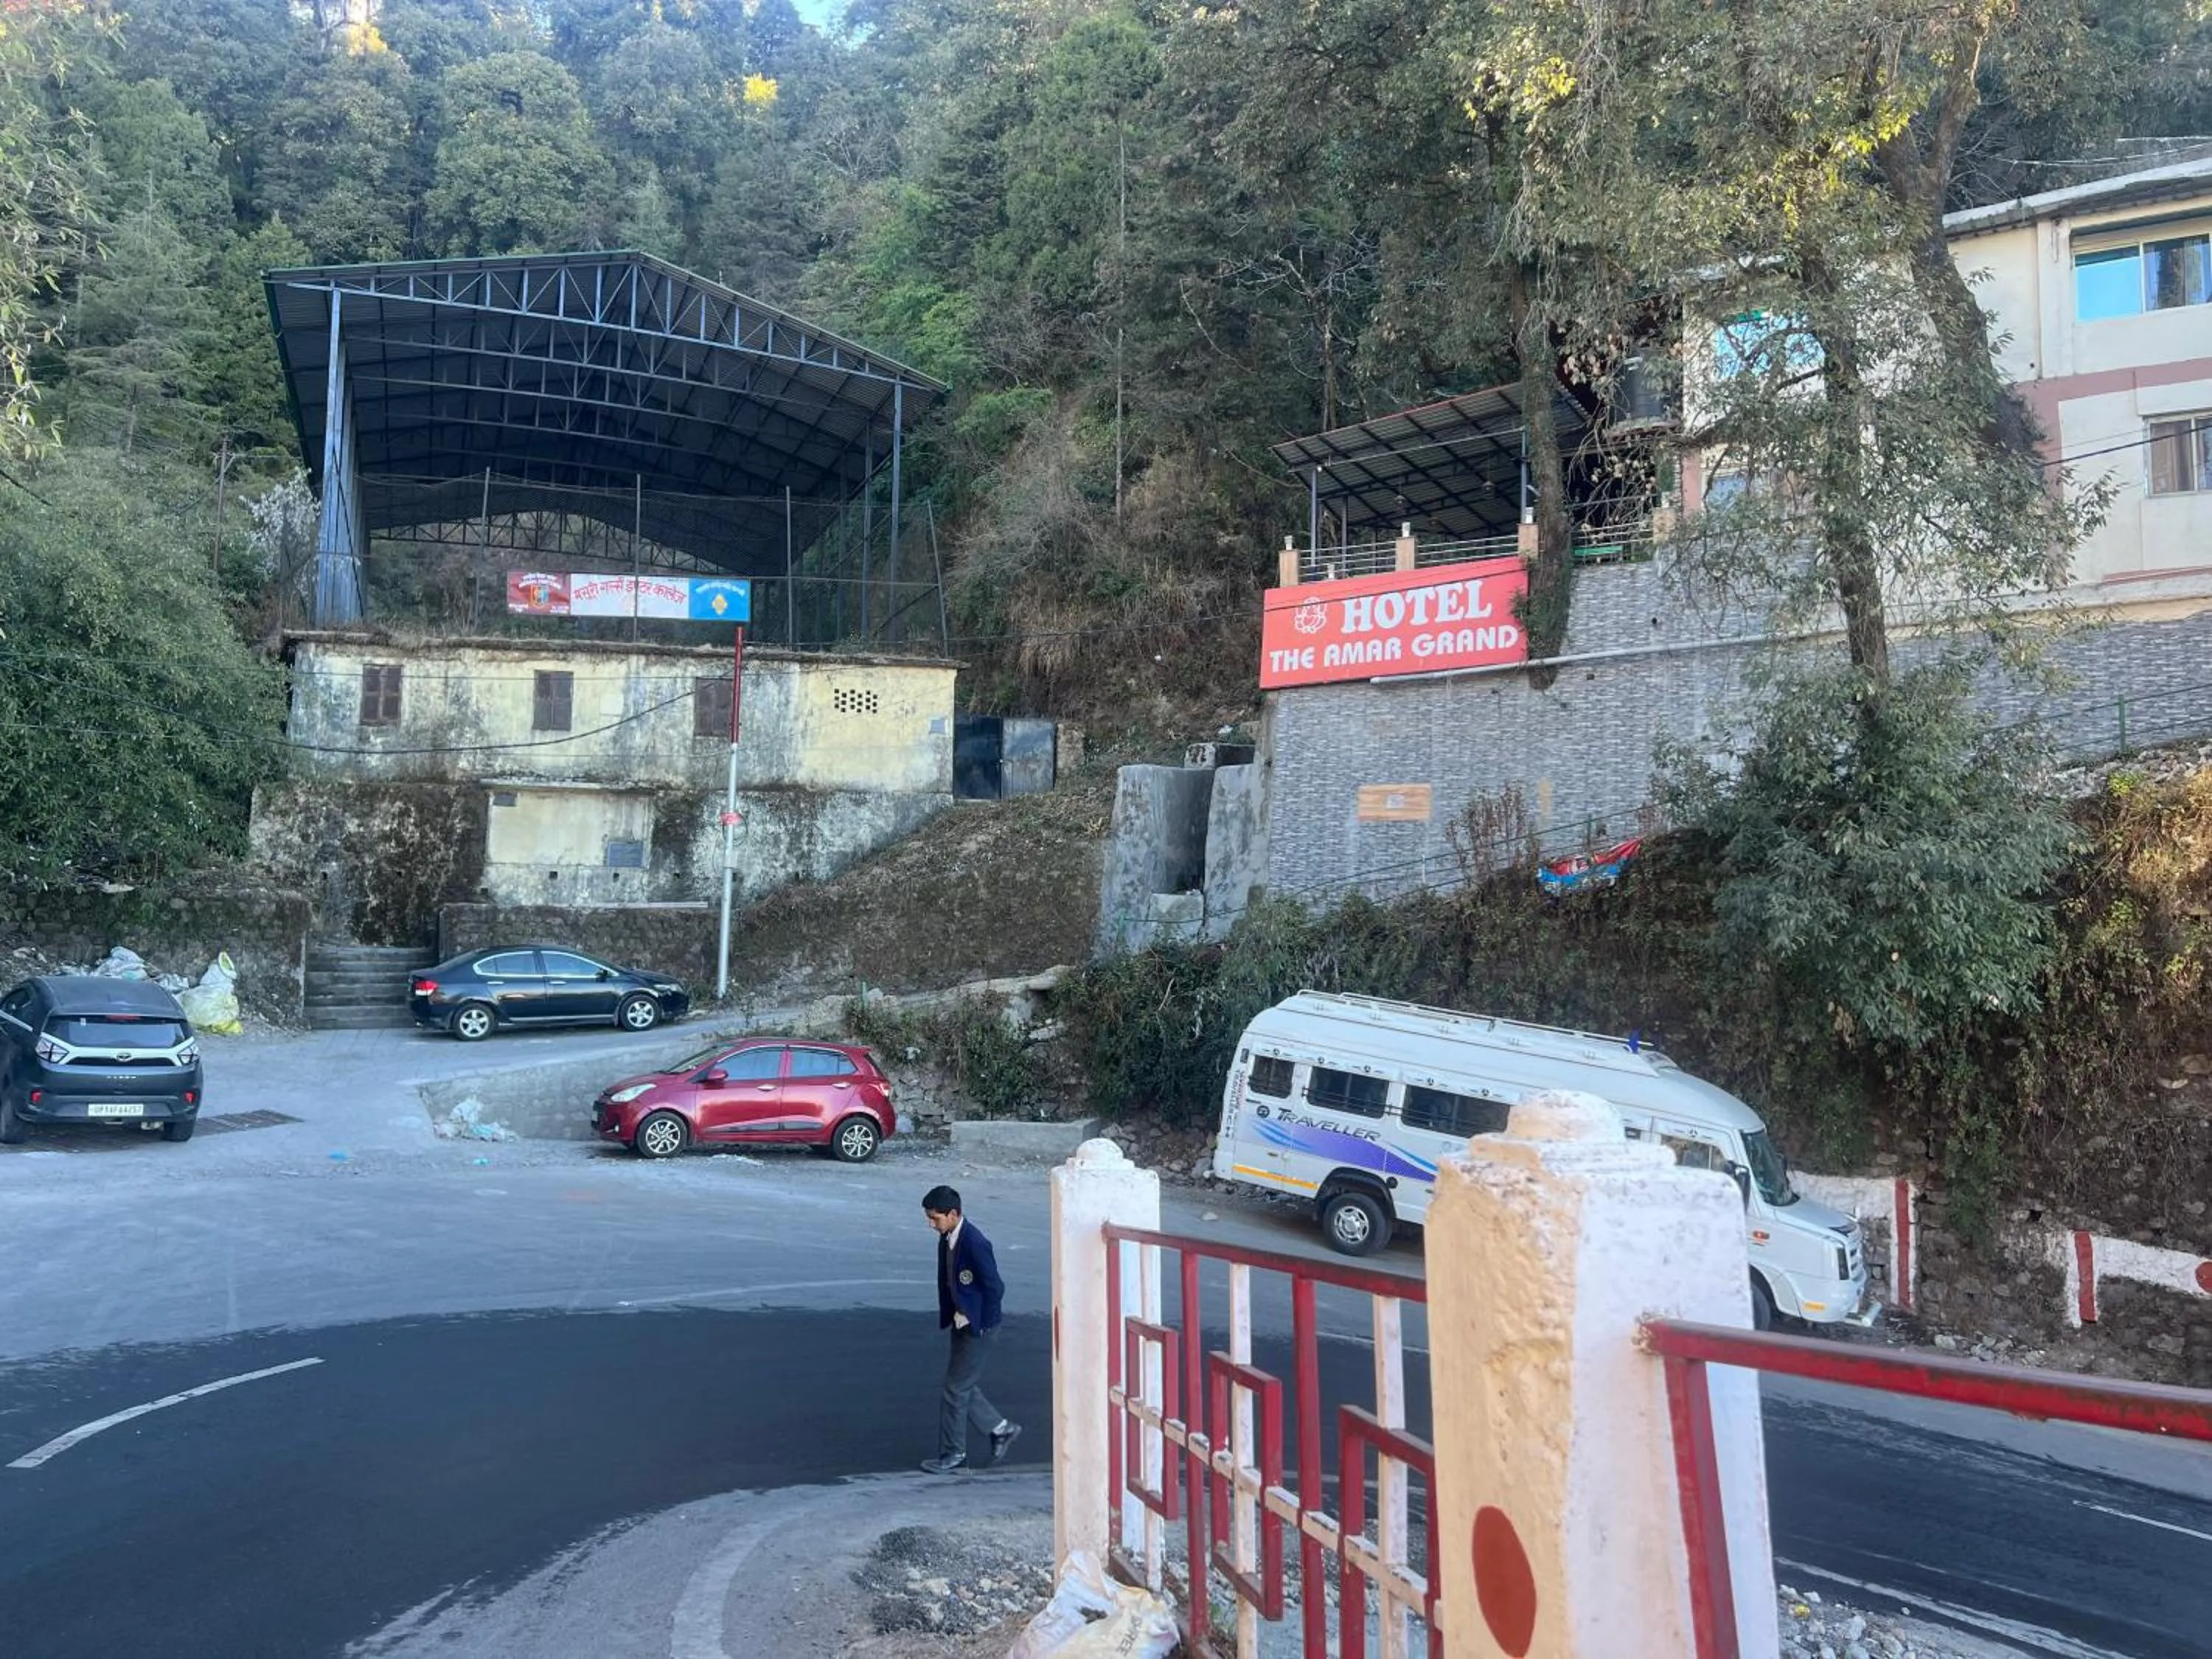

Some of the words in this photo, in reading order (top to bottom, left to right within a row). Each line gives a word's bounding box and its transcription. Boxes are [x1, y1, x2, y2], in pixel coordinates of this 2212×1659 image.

[1340, 580, 1492, 634] HOTEL
[1269, 646, 1315, 673] THE
[1324, 637, 1402, 667] AMAR
[1411, 625, 1519, 657] GRAND
[1277, 1106, 1381, 1142] TRAVELLER
